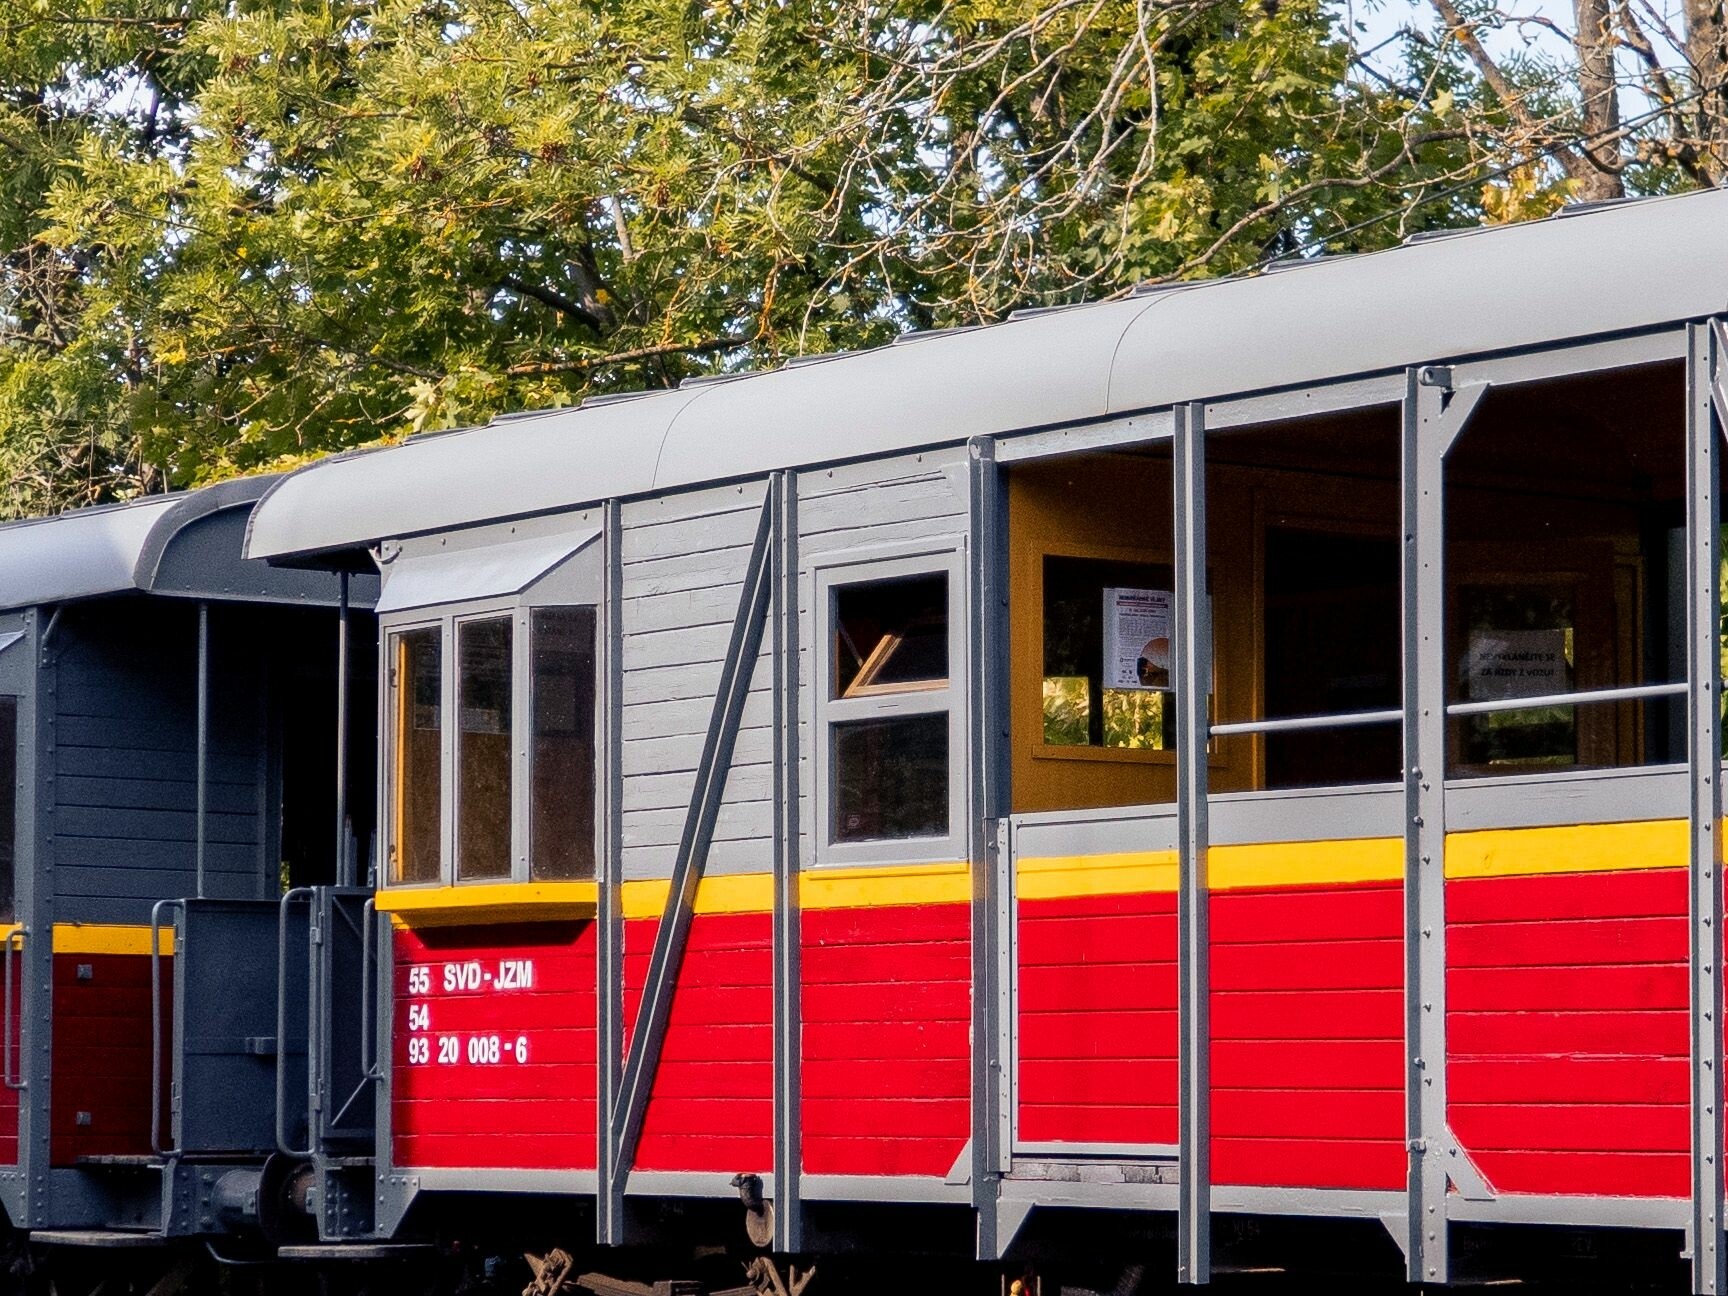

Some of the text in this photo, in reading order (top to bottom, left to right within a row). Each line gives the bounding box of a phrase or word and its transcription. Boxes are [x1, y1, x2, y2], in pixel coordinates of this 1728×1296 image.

[408, 966, 430, 994] 55
[408, 1004, 430, 1031] 54
[408, 1037, 430, 1064] 93
[437, 1036, 459, 1064] 20
